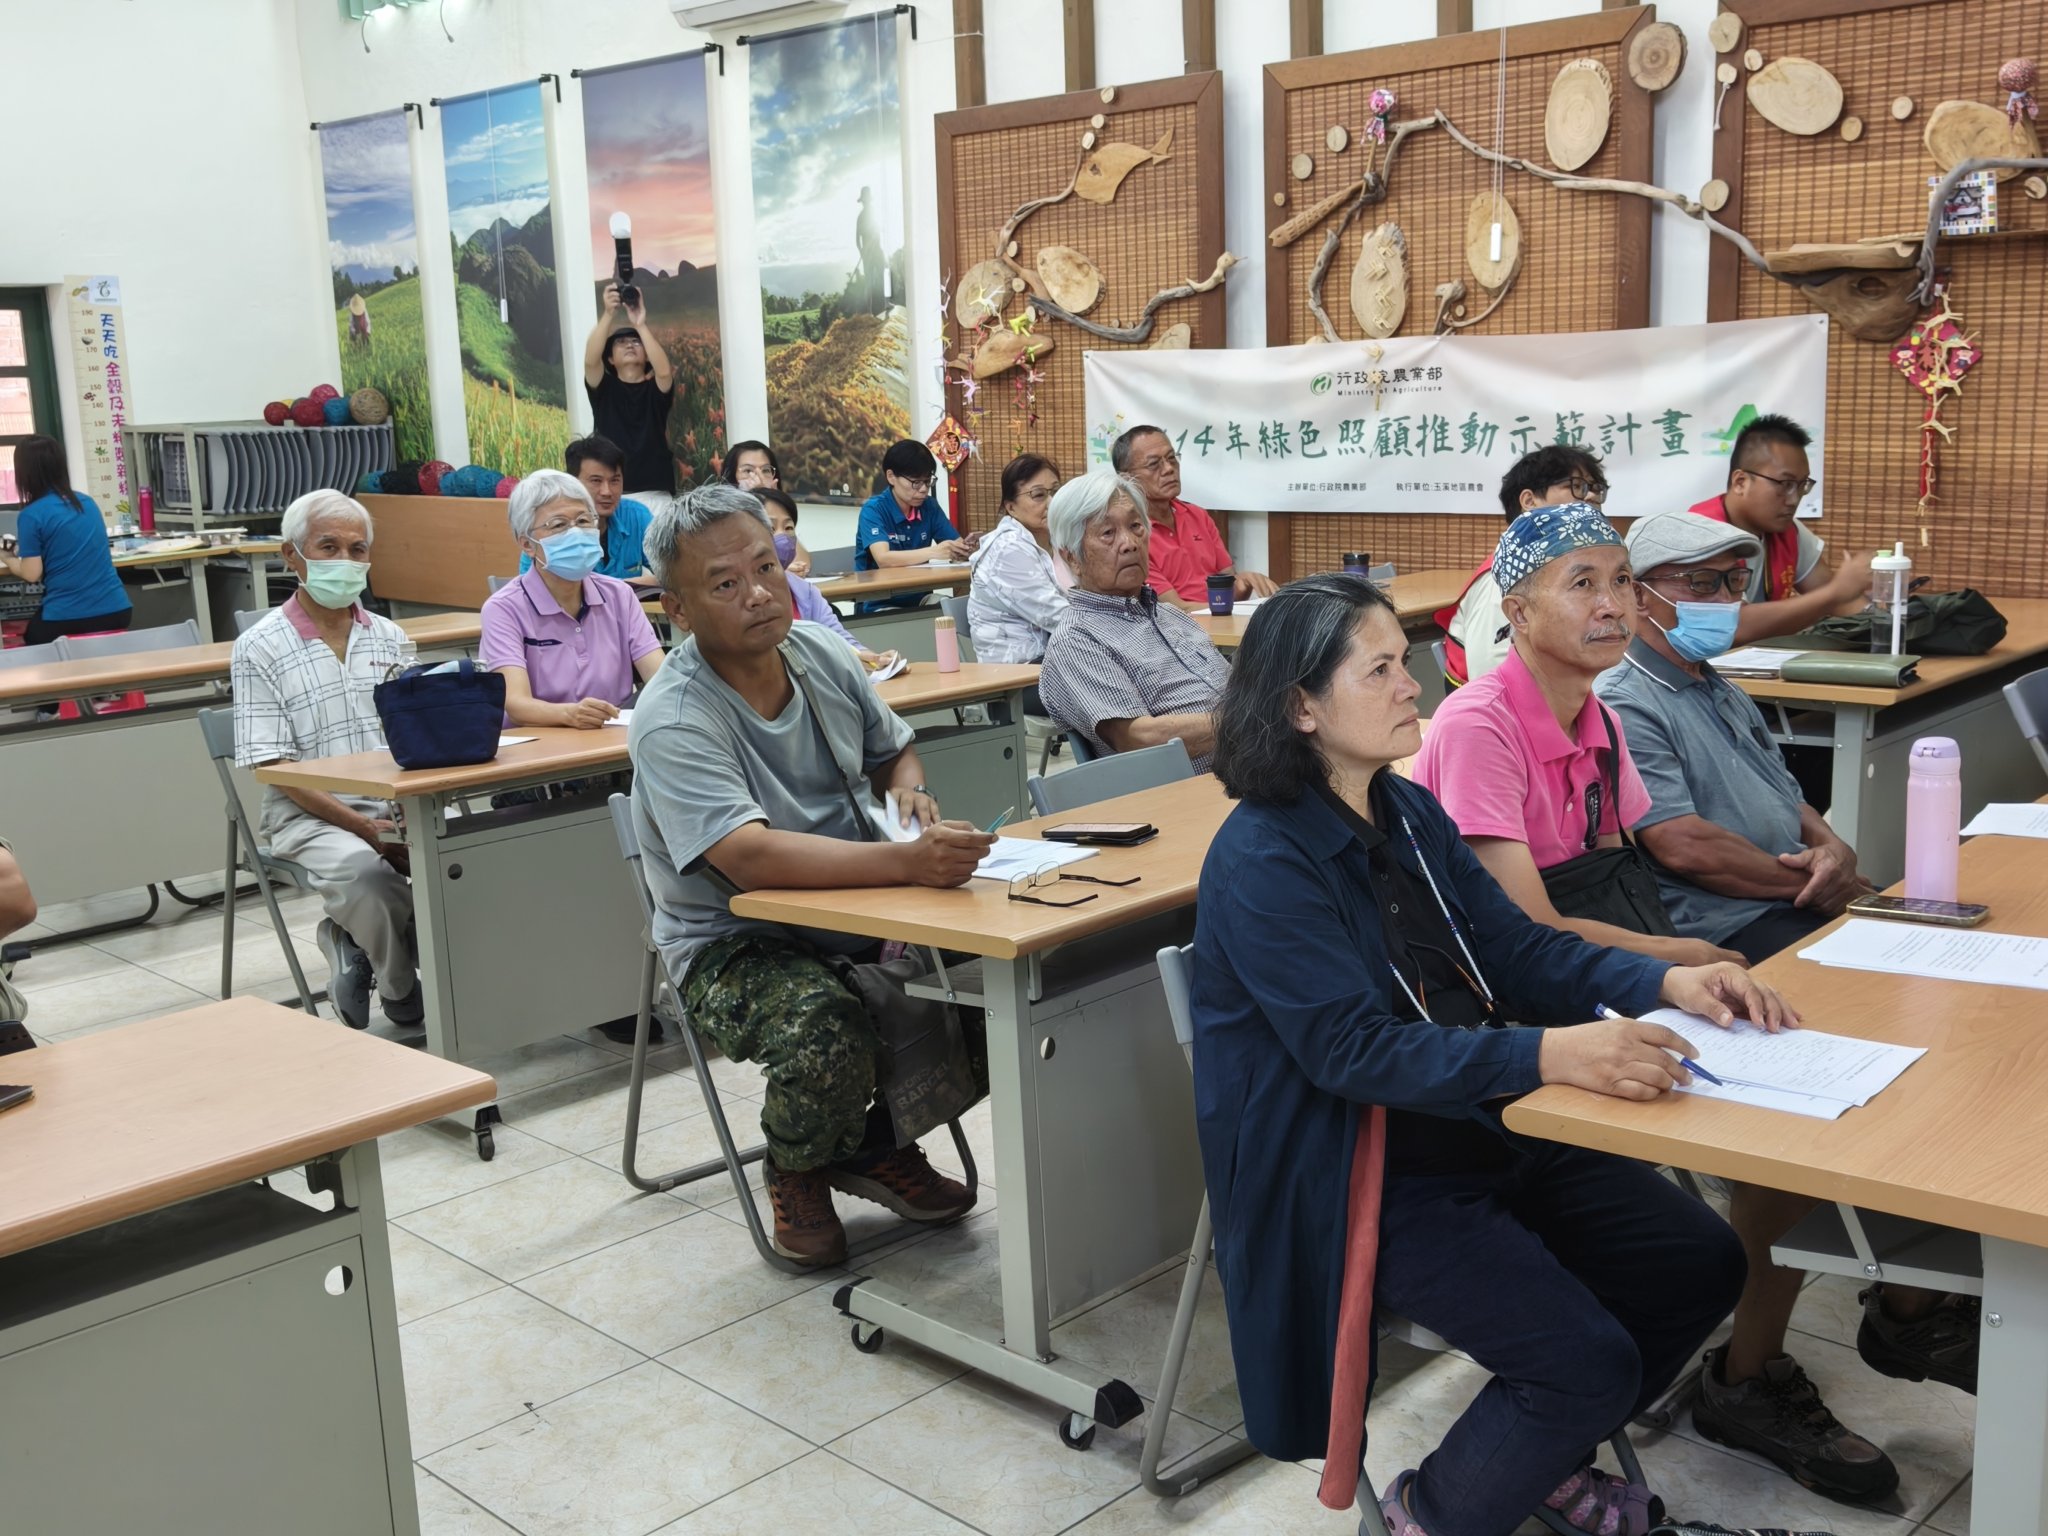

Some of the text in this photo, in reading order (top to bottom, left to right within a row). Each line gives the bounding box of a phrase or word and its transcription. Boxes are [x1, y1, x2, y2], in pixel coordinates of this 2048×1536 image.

[1393, 386, 1442, 394] Agriculture
[1163, 408, 1693, 459] 14年綠色照顧推動示範計畫
